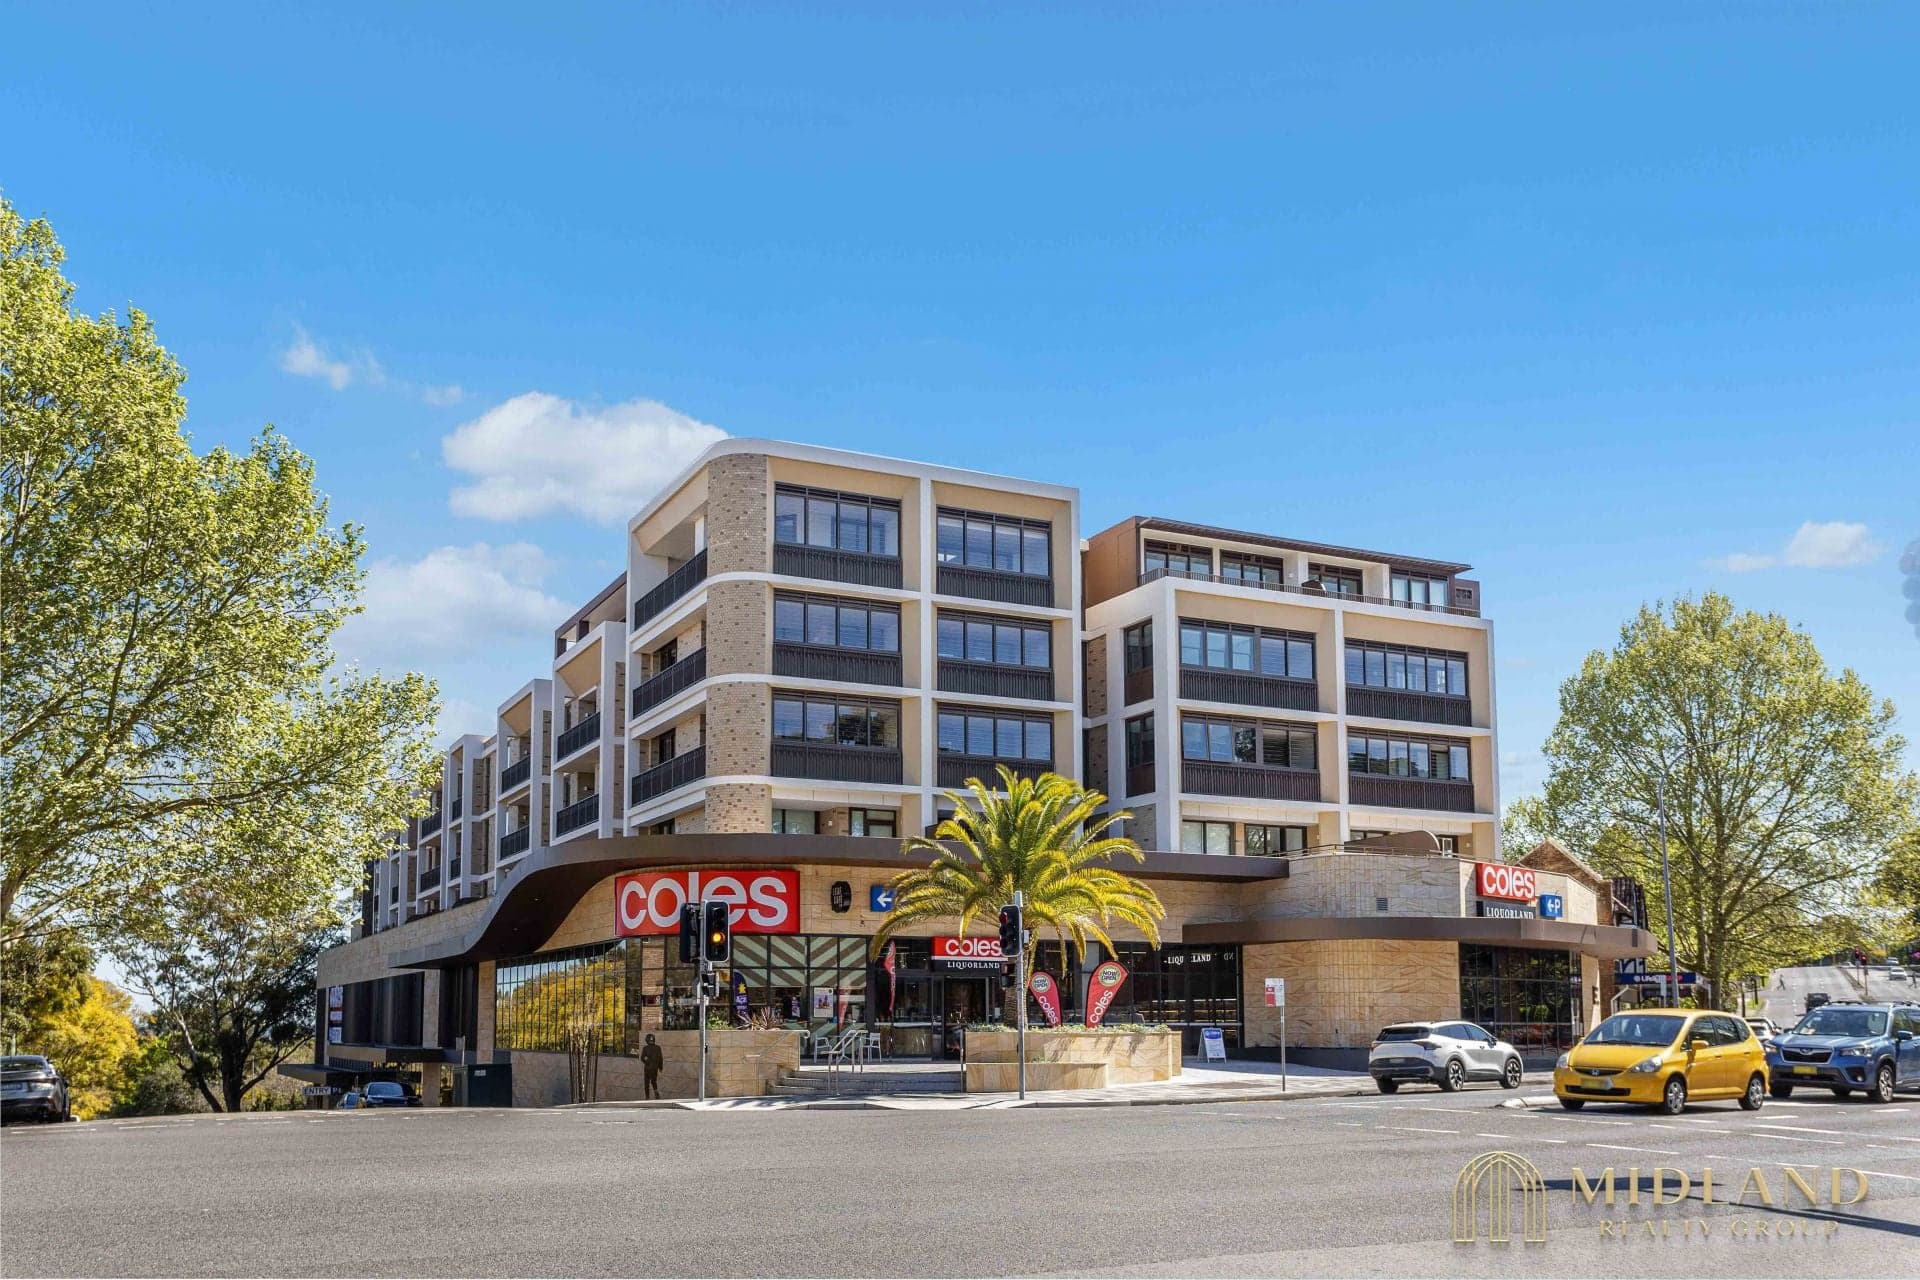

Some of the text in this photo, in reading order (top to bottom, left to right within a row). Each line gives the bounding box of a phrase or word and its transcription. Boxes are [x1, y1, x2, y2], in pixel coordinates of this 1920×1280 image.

[1484, 866, 1535, 898] coles
[621, 871, 788, 929] coles
[1486, 907, 1534, 919] LIQUORLAND
[945, 938, 1001, 956] coles
[947, 961, 1000, 970] LIQUORLAND
[1038, 995, 1059, 1025] coles
[1090, 990, 1113, 1024] coles
[304, 1087, 329, 1096] ENTRY
